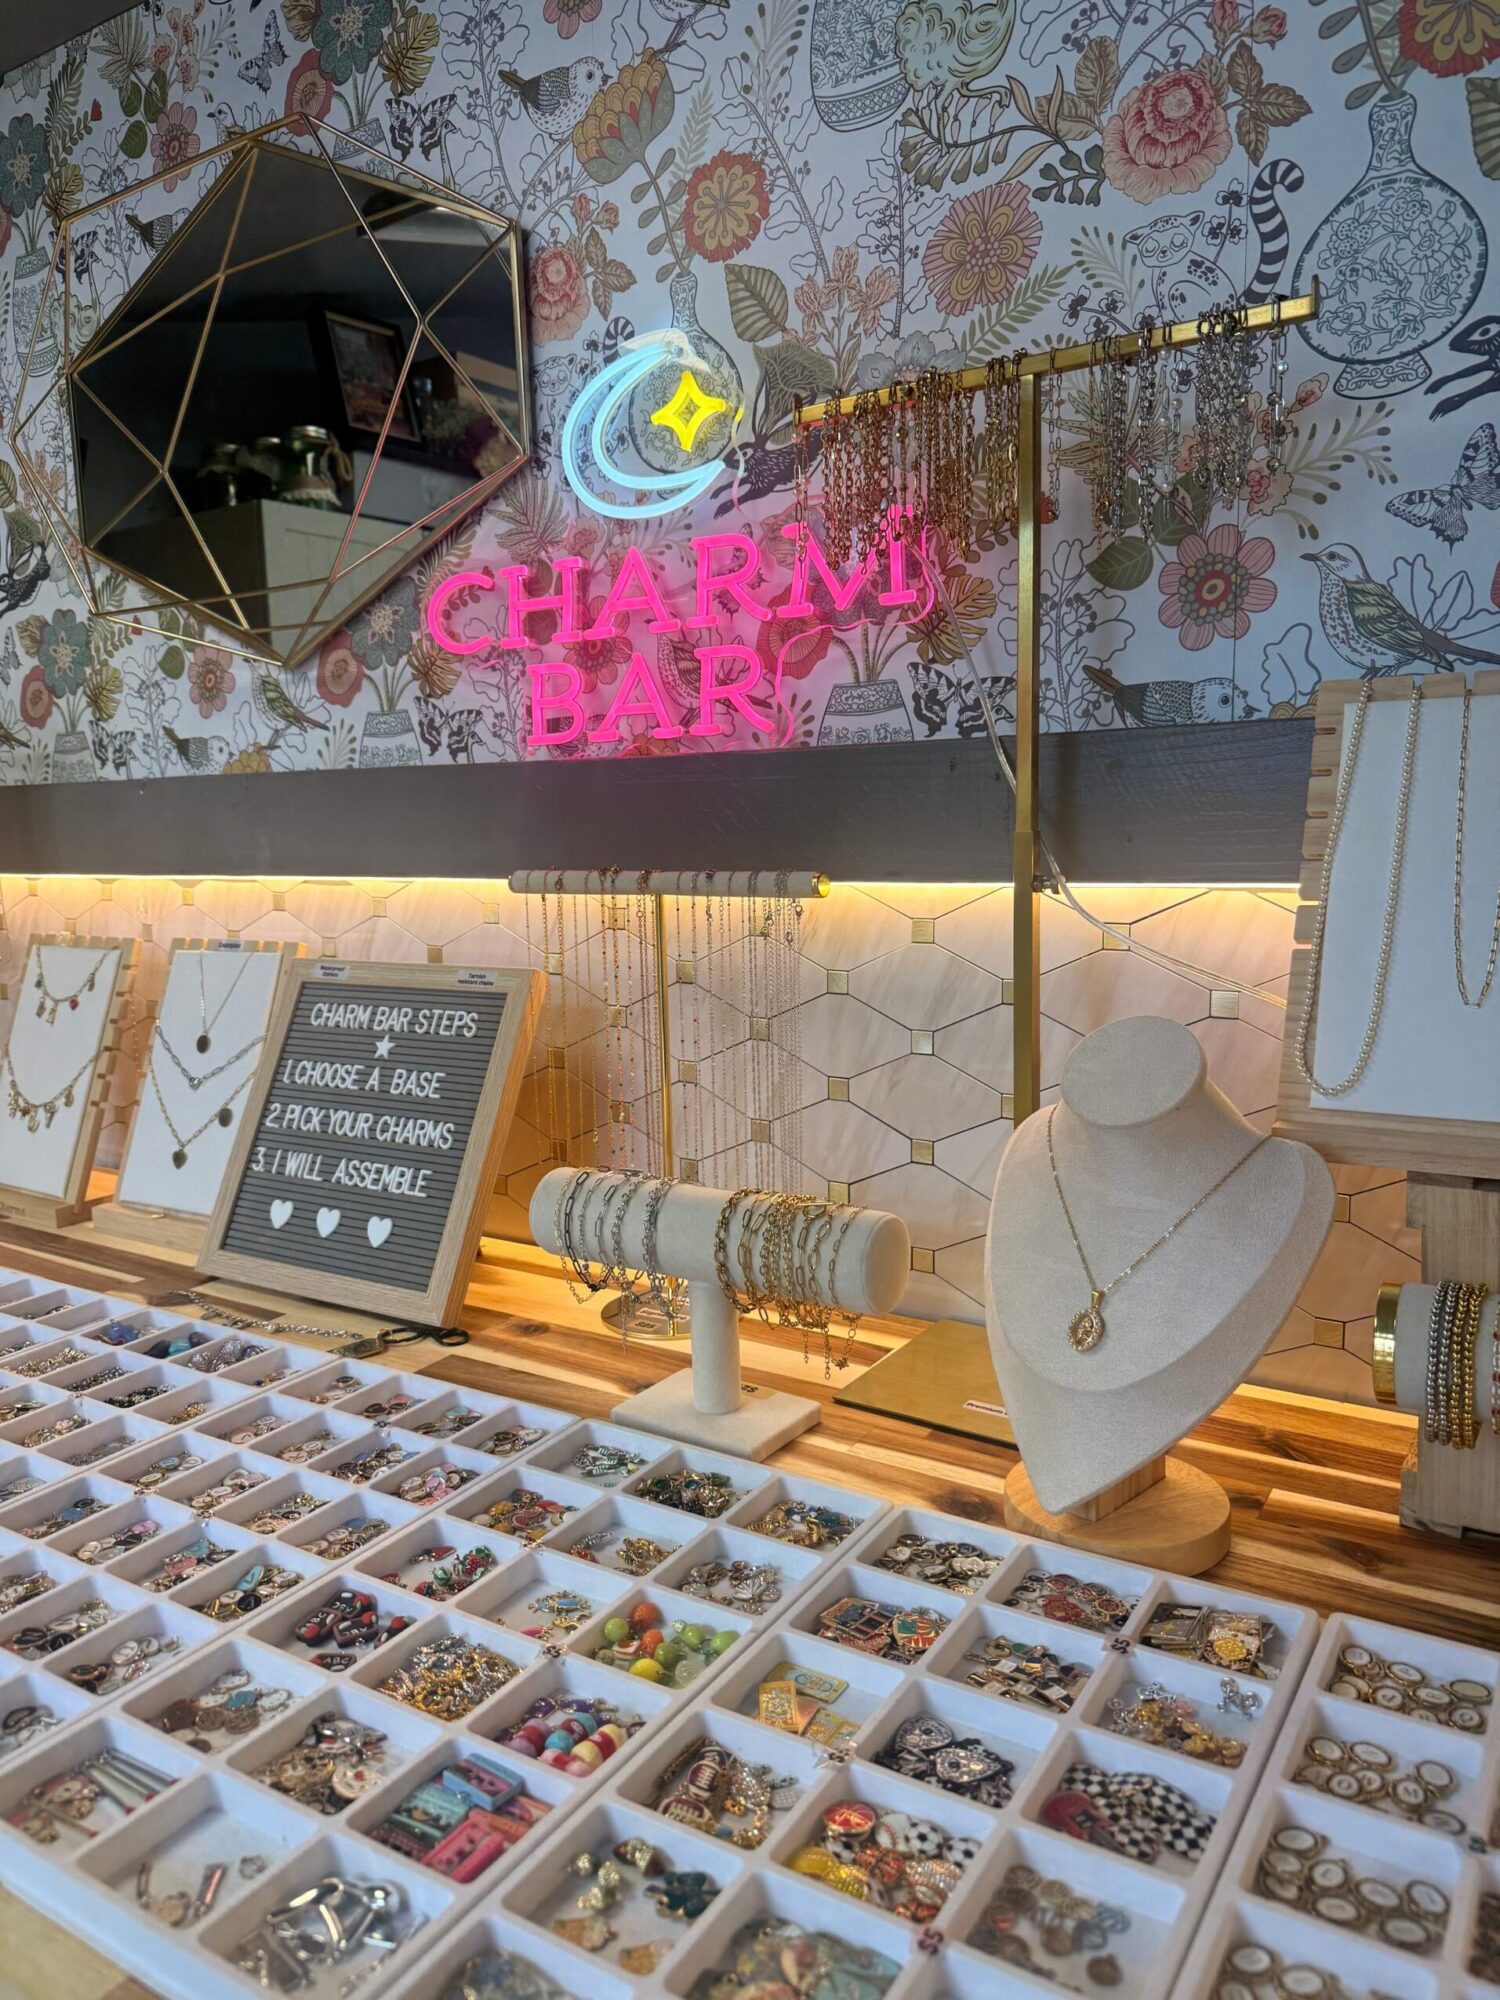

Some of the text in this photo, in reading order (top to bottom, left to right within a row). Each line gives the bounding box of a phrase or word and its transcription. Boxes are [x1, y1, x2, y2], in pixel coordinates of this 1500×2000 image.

[427, 503, 918, 655] CHARM
[526, 645, 775, 747] BAR
[310, 1002, 479, 1038] CHARM BAR STEPS
[295, 1059, 366, 1091] CHOOSE
[364, 1066, 381, 1092] A
[389, 1068, 447, 1099] BASE
[264, 1102, 455, 1150] 2 PICK YOUR CHARMS
[271, 1149, 283, 1175] I
[285, 1150, 324, 1182] WILL
[331, 1157, 433, 1198] ASSEMBLE
[323, 1656, 349, 1665] ABC
